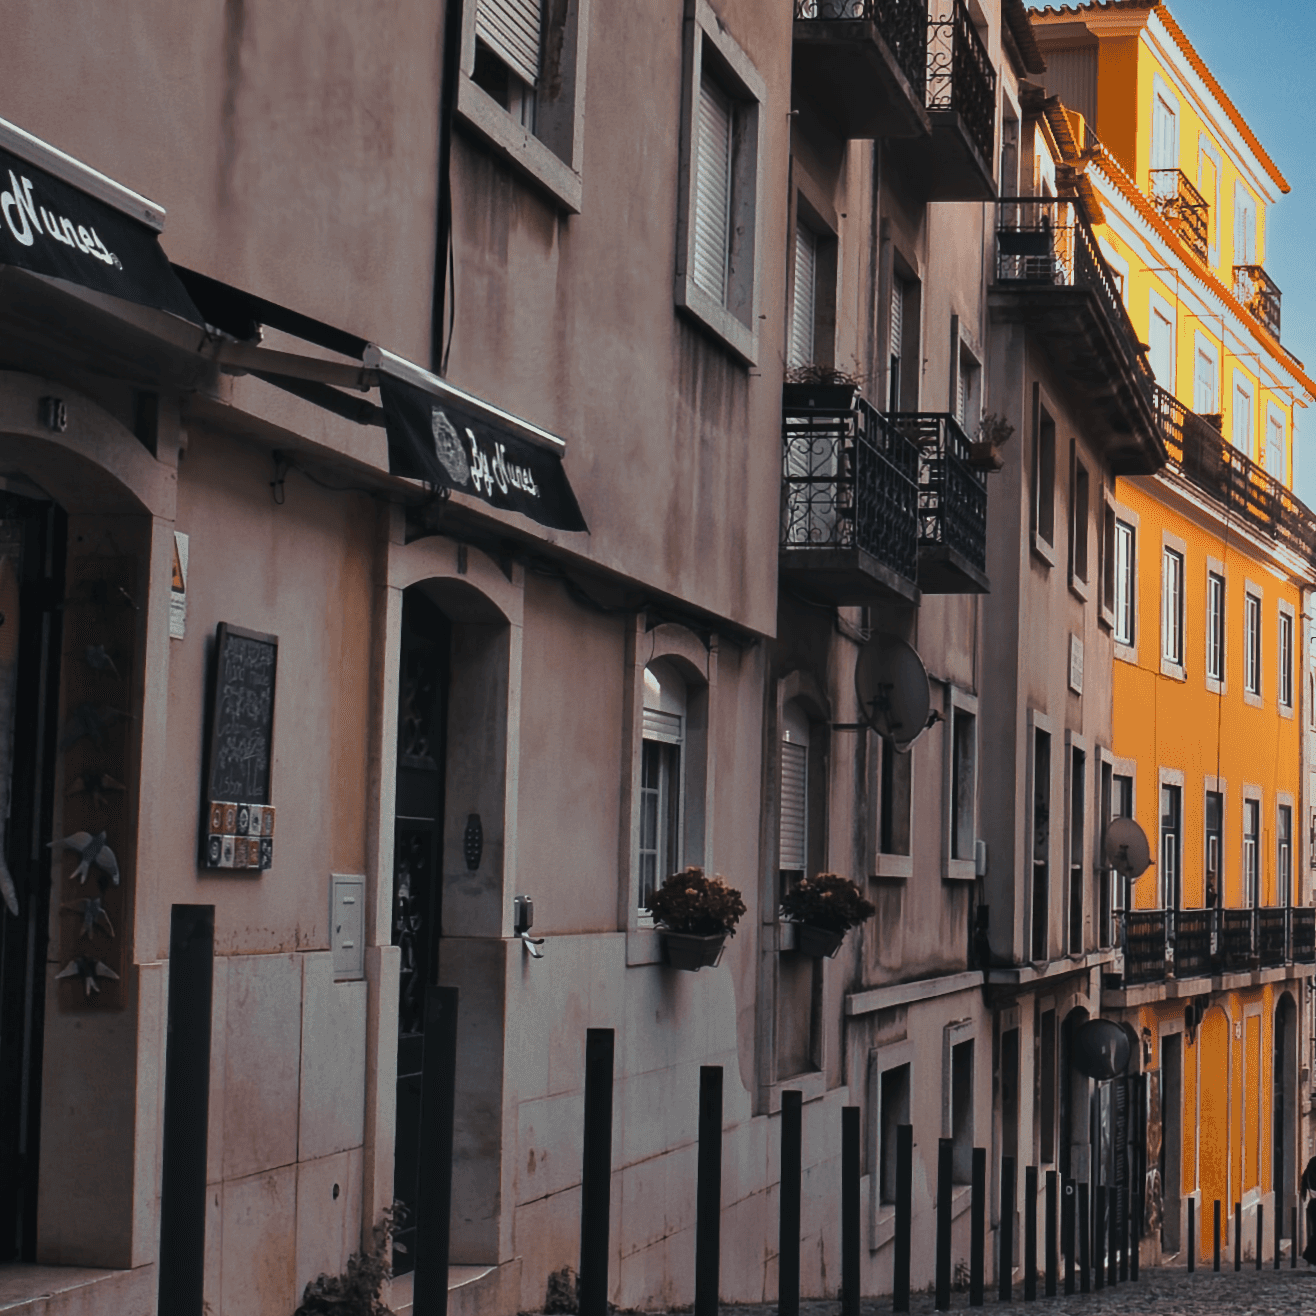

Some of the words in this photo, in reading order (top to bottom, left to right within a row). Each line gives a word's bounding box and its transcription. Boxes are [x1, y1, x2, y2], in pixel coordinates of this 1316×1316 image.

[1, 169, 113, 265] Nunes
[465, 427, 494, 497] By
[492, 442, 537, 496] Nunes
